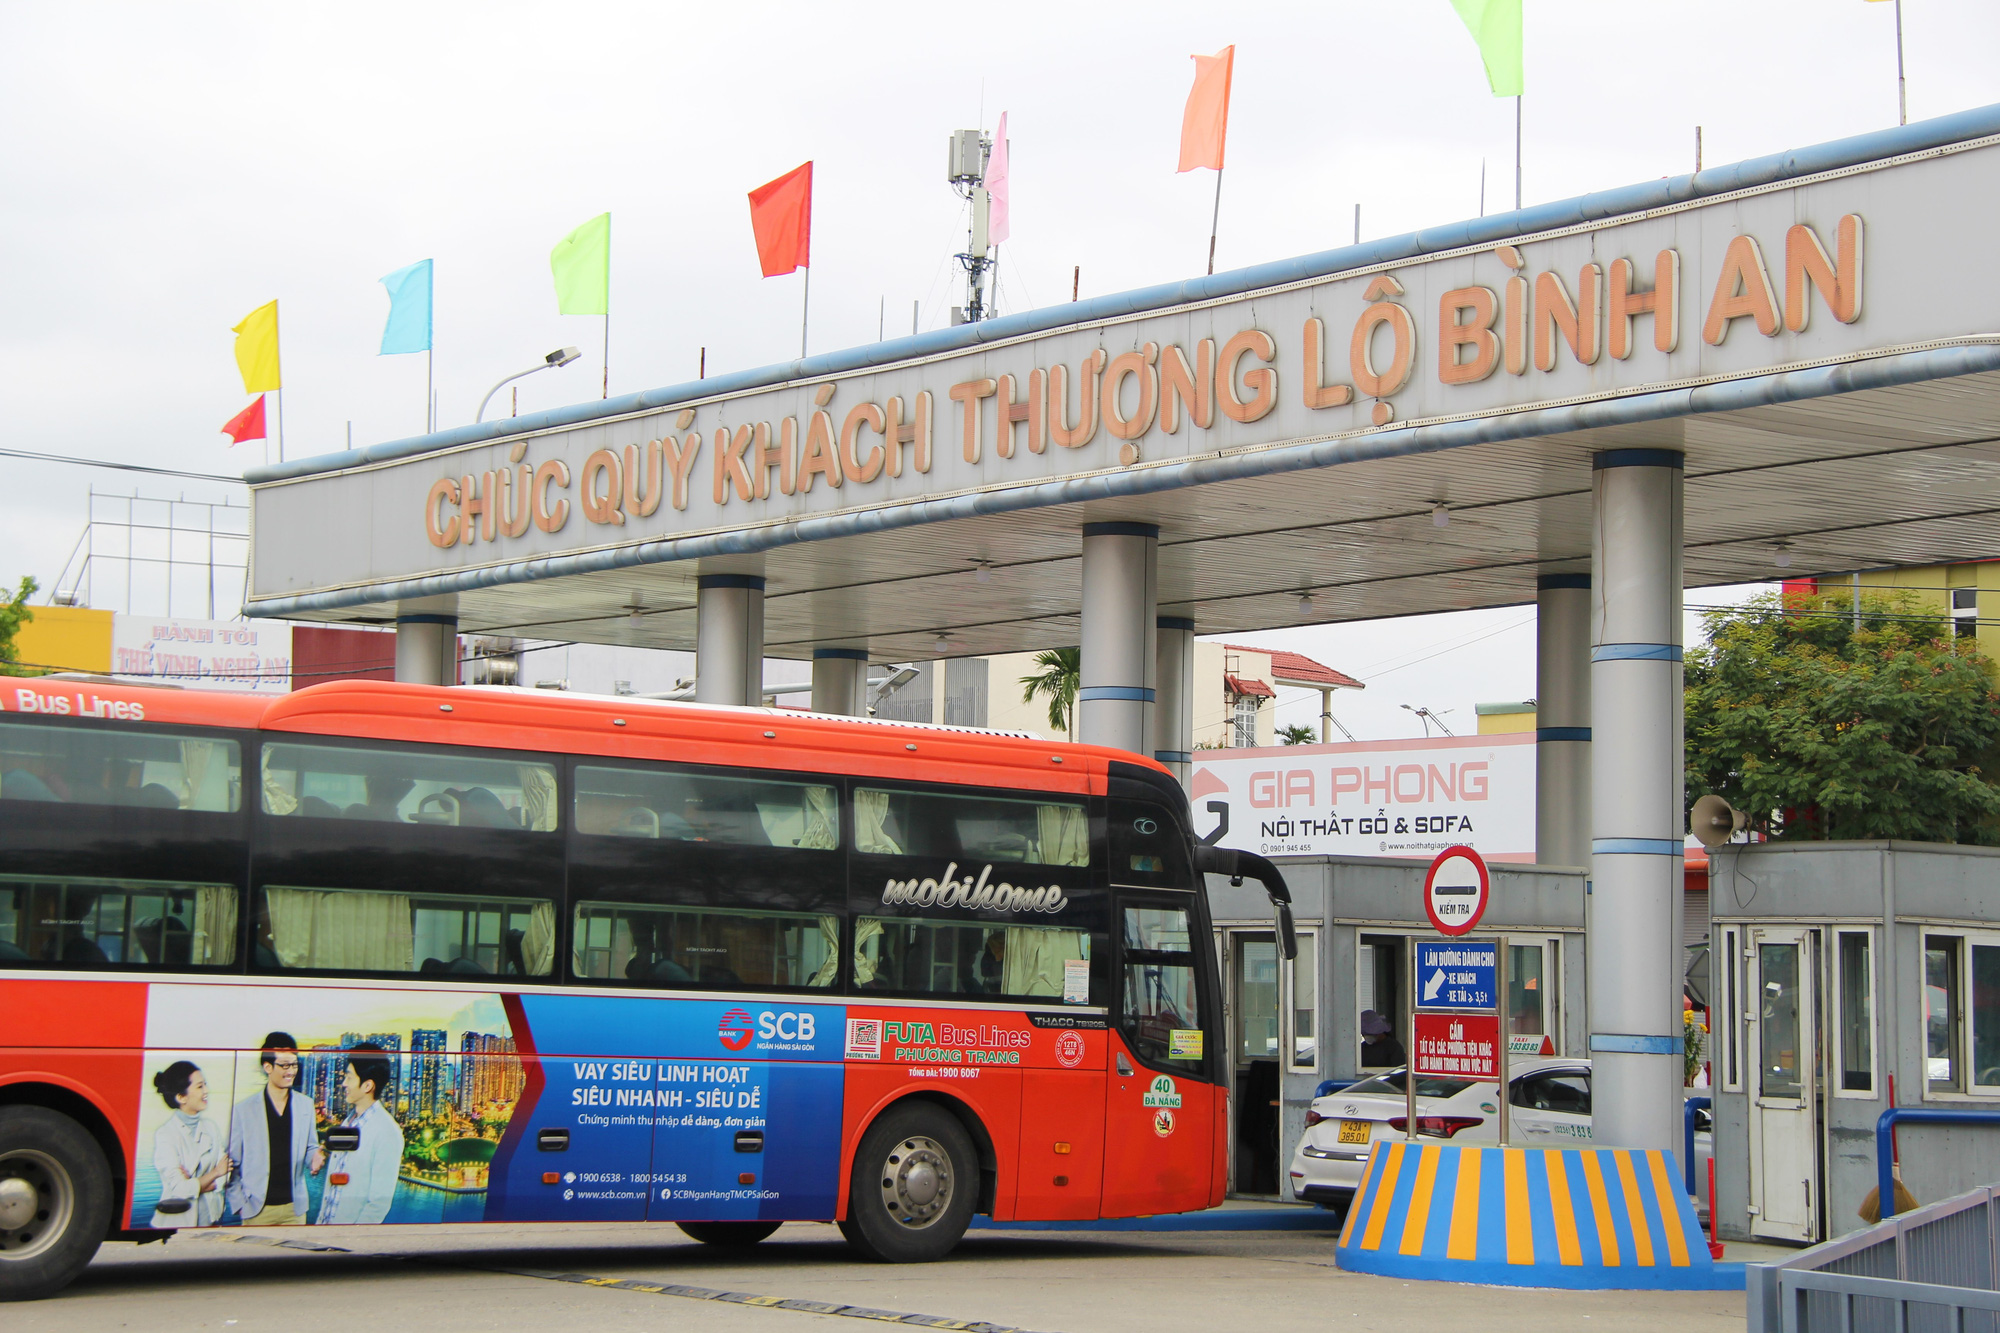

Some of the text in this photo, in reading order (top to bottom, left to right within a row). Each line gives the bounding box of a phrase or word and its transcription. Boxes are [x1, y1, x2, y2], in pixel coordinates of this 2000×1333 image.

[425, 214, 1864, 548] CHÚC QUÝ KHÁCH THƯỢNG LỘ BÌNH AN
[156, 652, 201, 680] VINH
[211, 651, 261, 689] NGHỆ
[262, 657, 289, 684] AN
[16, 688, 71, 715] Bus
[77, 693, 145, 720] Lines
[1249, 761, 1489, 809] GIA PHONG
[1261, 808, 1473, 842] NỘI THẤT GỖ & SOFA
[1286, 844, 1298, 852] 945
[882, 861, 1068, 913] mobihome
[1458, 904, 1469, 914] TRA
[1425, 947, 1494, 966] LÀN ĐƯỜNG DÀNH CHO
[1457, 970, 1477, 984] KHÁCH
[1457, 986, 1466, 1002] TẢI
[758, 1011, 816, 1040] SCB
[1034, 1017, 1075, 1026] THACO
[1449, 1019, 1463, 1040] CẤM
[883, 1020, 1031, 1048] FUTA Bus Lines
[757, 1042, 815, 1051] NGÂN HÀNG SÀI GÒN
[1428, 1036, 1436, 1054] CẢ
[1436, 1038, 1446, 1055] CÁC
[1478, 1040, 1492, 1056] KHÁC
[895, 1046, 1020, 1064] PHƯƠNG TRANG
[939, 1067, 958, 1077] 1900
[961, 1068, 980, 1078] 6067
[1460, 1058, 1470, 1072] KHU
[1481, 1057, 1492, 1073] NÀY
[574, 1061, 750, 1088] VAY SIÊU LINH HOẠT
[1155, 1079, 1170, 1093] 40
[571, 1085, 612, 1106] SIÊU
[616, 1089, 683, 1107] NHANH
[695, 1087, 733, 1108] SIÊU
[738, 1085, 761, 1109] DỄ
[1145, 1095, 1156, 1105] ĐÀ
[578, 1113, 766, 1129] Chứng minh thu nhập dễ dàng, đơn giản
[1348, 1122, 1361, 1132] 43A
[1340, 1132, 1365, 1142] 385.01
[579, 1173, 599, 1182] 1900
[600, 1173, 621, 1183] 6538
[630, 1173, 651, 1183] 1800
[676, 1173, 687, 1183] 38
[578, 1189, 646, 1199] www.scb.com.vn
[673, 1189, 779, 1201] SCBNganHangTMCPSaiGon
